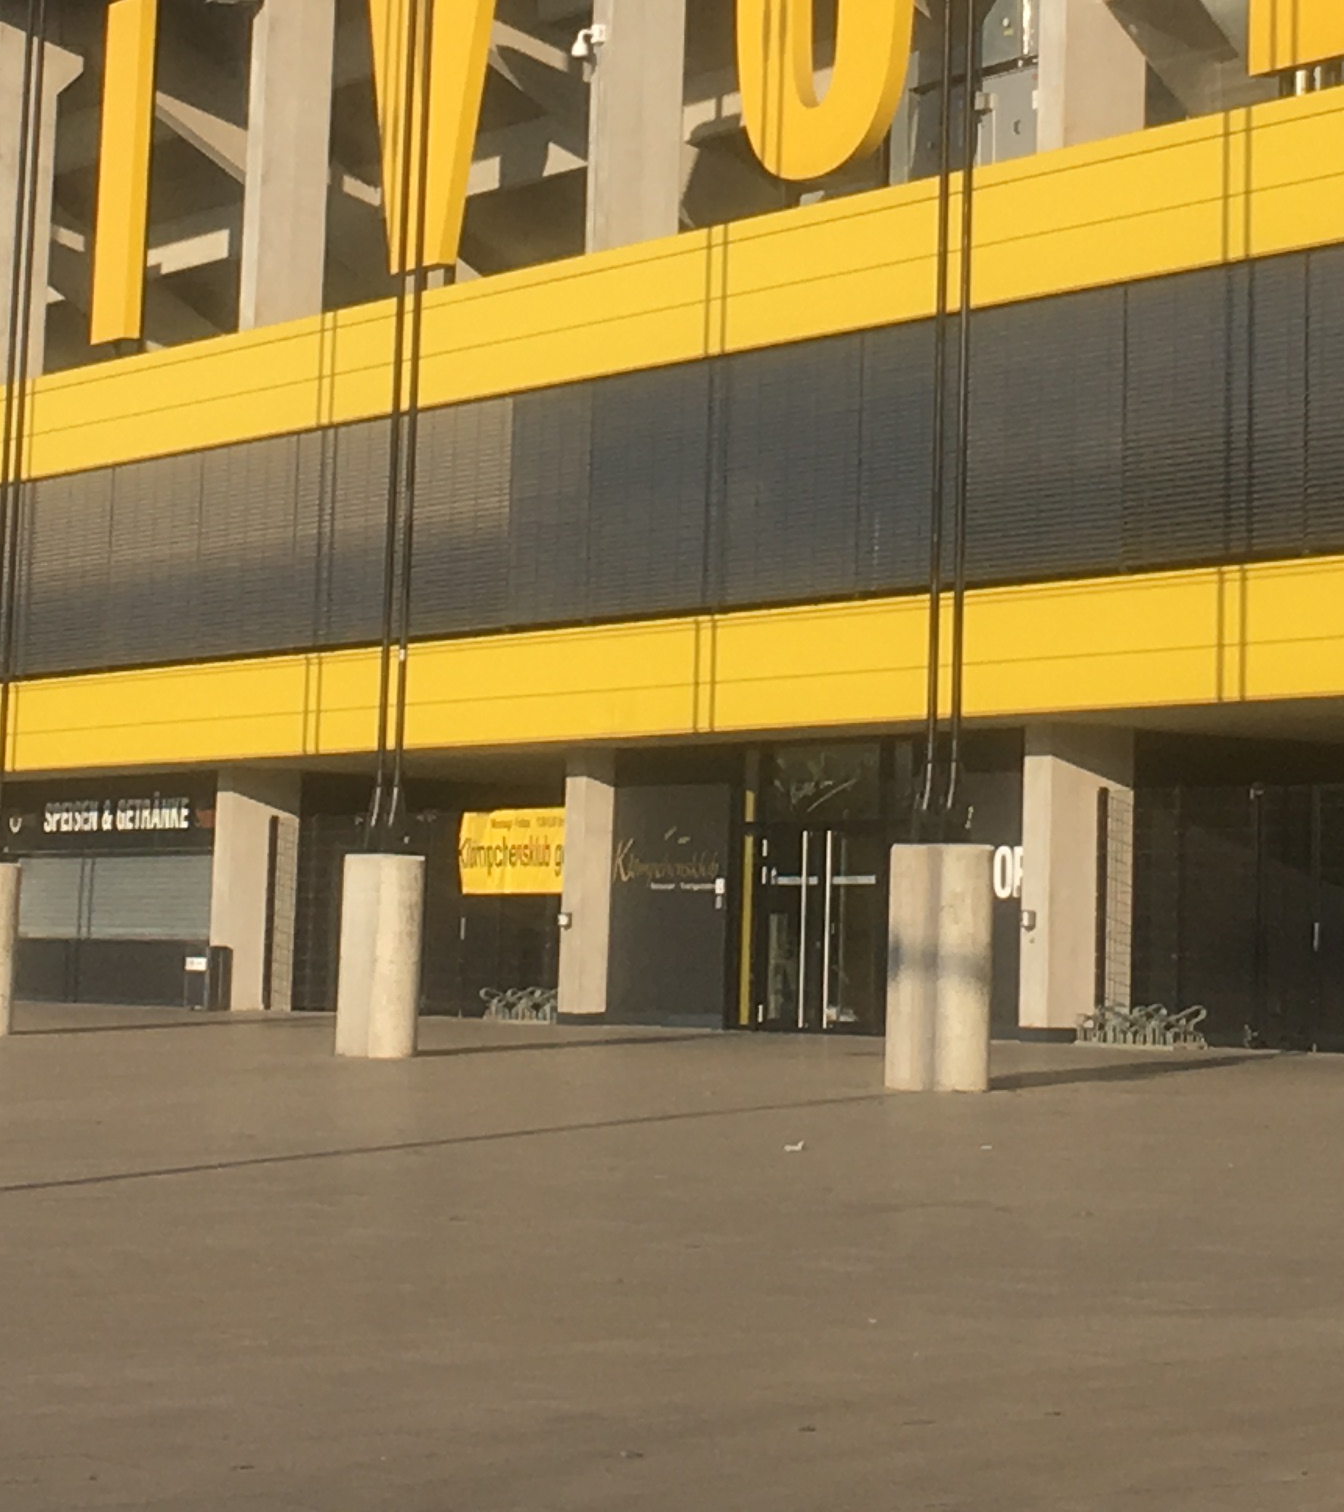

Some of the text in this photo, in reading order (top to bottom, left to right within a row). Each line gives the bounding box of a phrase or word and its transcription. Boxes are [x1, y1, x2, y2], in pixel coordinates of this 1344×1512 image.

[43, 800, 99, 833] SPEISEN
[101, 799, 113, 831] &
[116, 791, 190, 830] GETRÄNKE
